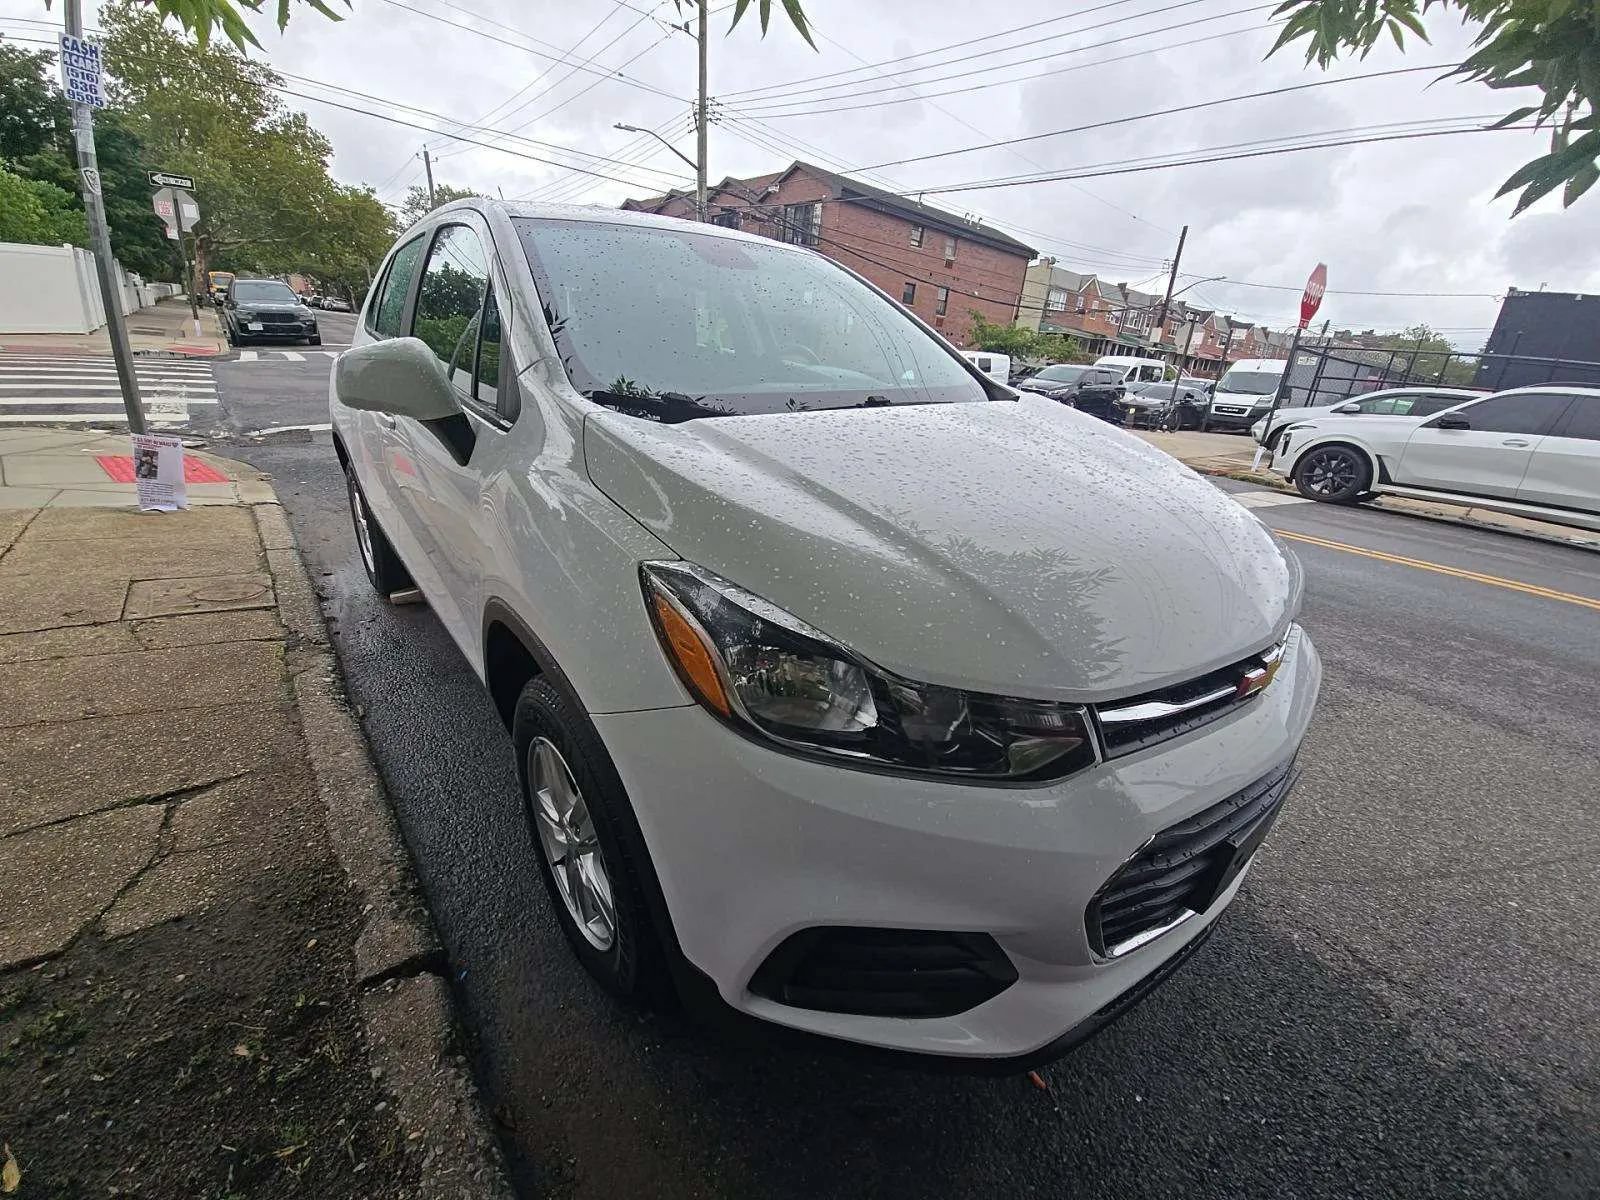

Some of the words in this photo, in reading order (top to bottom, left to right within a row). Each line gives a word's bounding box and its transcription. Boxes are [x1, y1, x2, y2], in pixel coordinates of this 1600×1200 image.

[66, 66, 99, 84] (516)
[69, 78, 98, 95] 636
[66, 88, 104, 107] 9595
[1303, 281, 1324, 305] STOP
